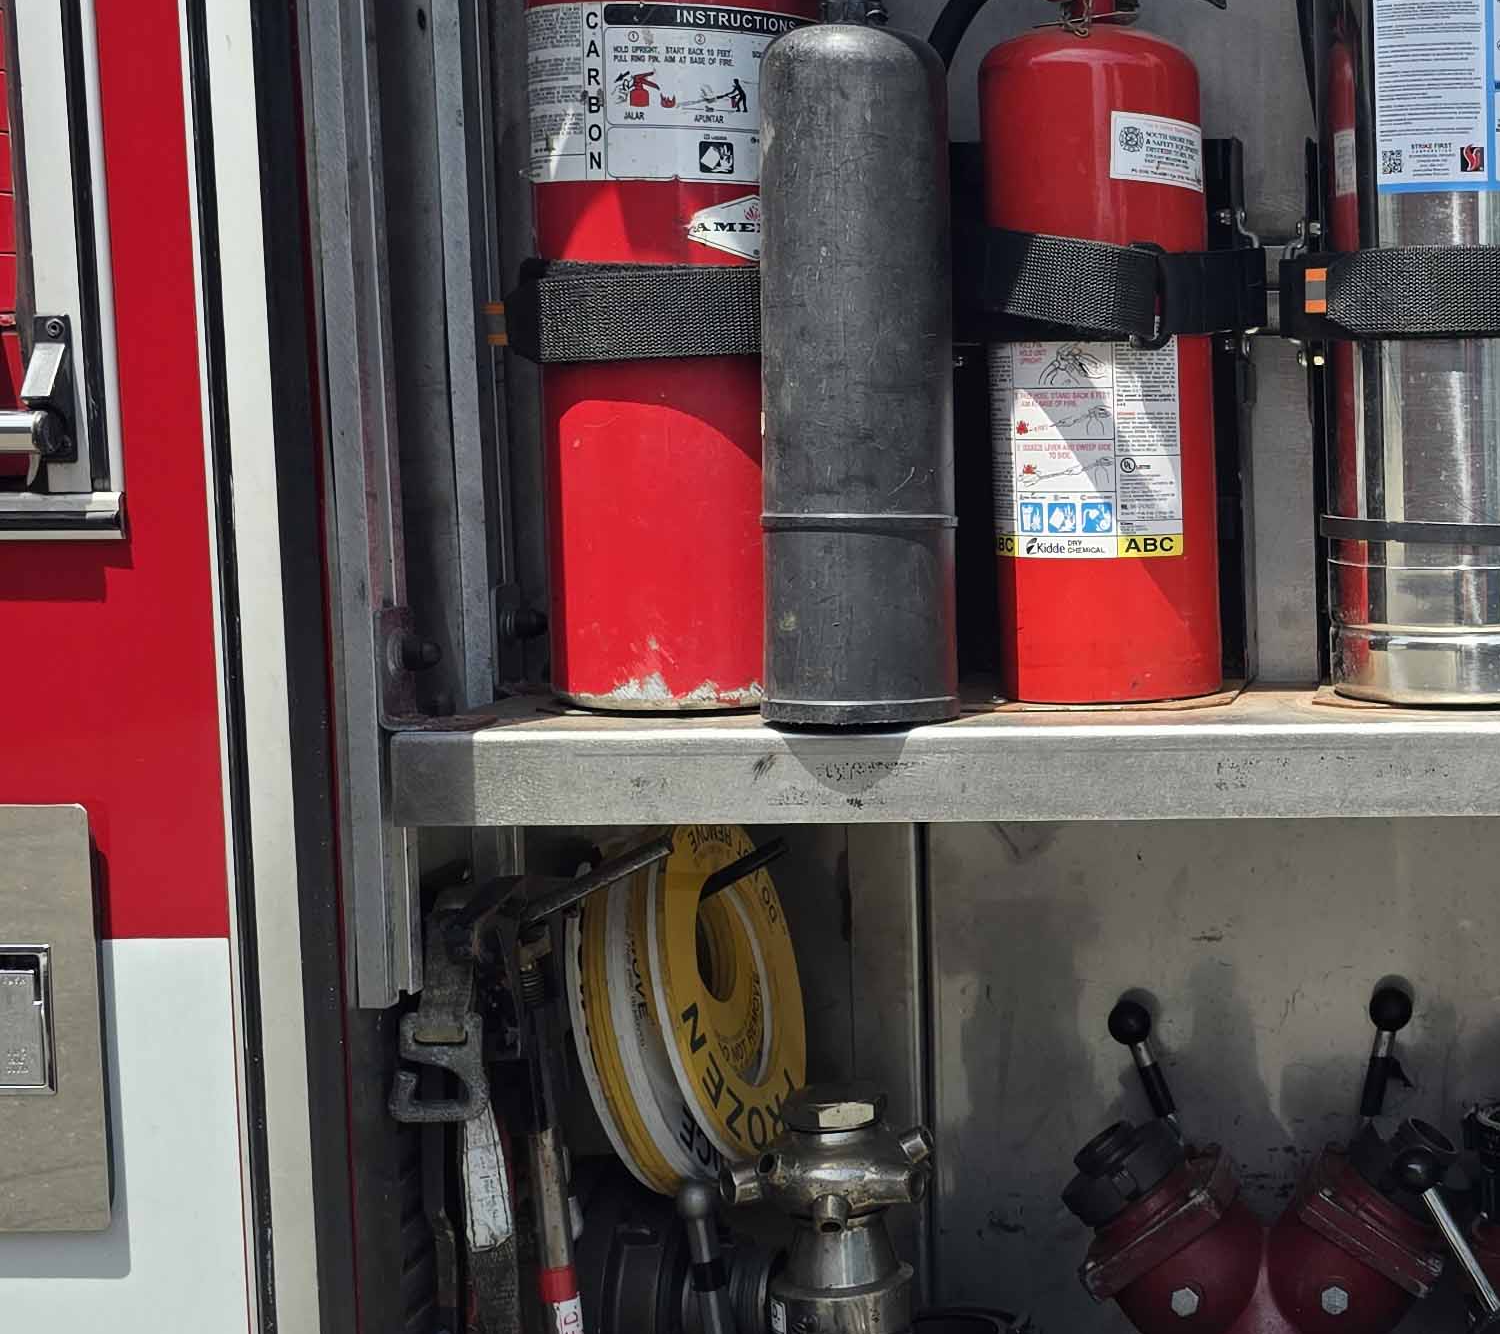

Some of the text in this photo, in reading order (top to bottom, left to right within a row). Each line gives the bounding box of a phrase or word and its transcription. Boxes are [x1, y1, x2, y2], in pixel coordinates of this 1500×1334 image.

[676, 9, 797, 31] INSTRUCTIONS
[665, 47, 685, 55] START
[687, 48, 704, 56] BACK
[613, 54, 629, 63] PULL
[631, 55, 646, 63] RING
[664, 55, 676, 63] AIM
[678, 56, 687, 64] AT
[689, 56, 706, 65] BASE
[586, 12, 602, 169] CARBON
[693, 222, 760, 233] AME
[1036, 542, 1065, 554] Kidde
[1068, 546, 1106, 554] CHEMICAL
[1125, 537, 1174, 553] ABC
